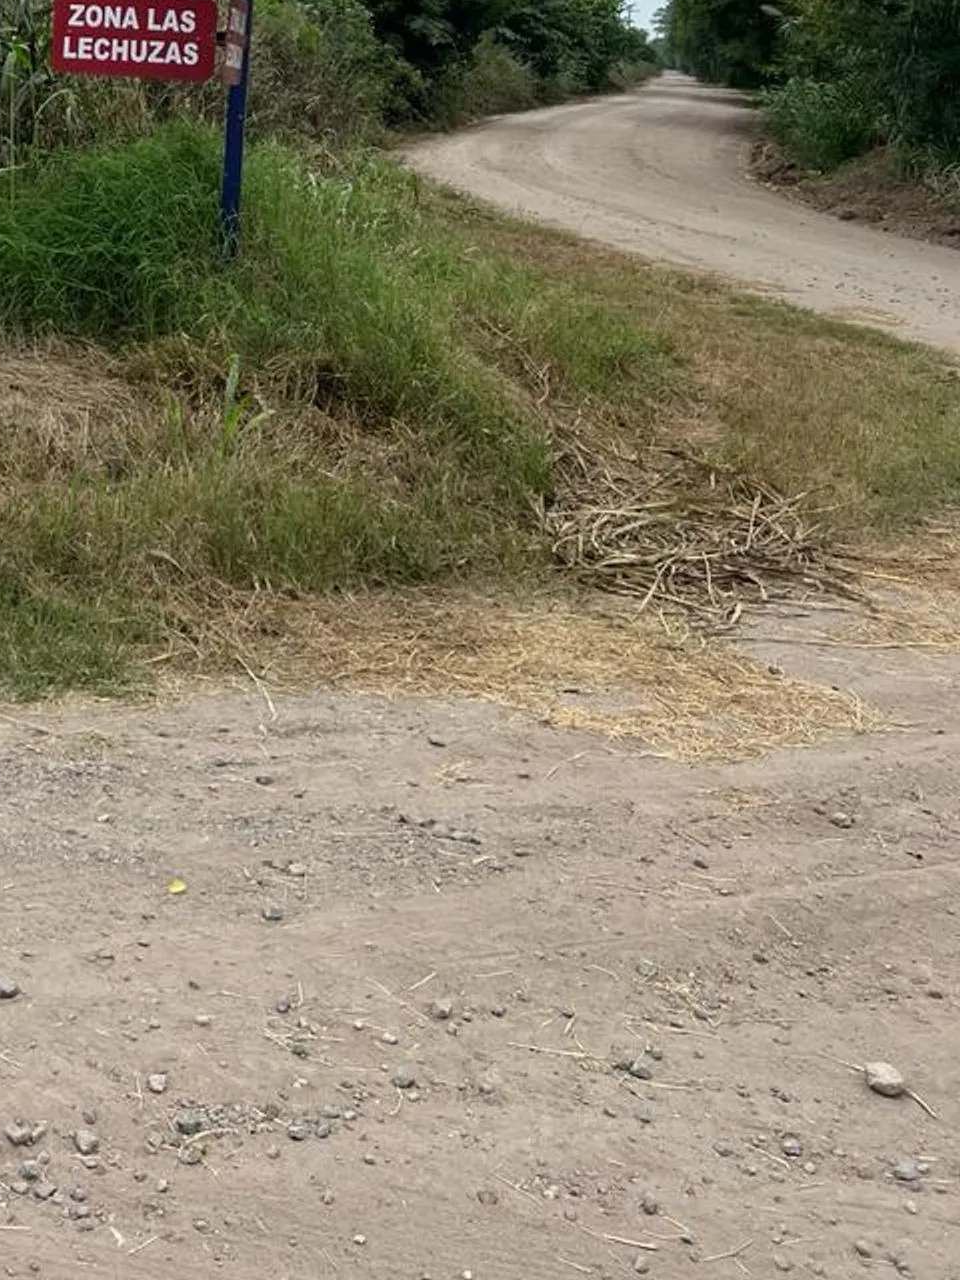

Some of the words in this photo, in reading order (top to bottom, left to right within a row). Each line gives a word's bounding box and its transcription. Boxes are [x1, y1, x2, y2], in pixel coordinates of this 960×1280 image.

[68, 4, 139, 30] ZONA
[147, 8, 196, 34] LAS
[63, 36, 200, 66] LECHUZAS
